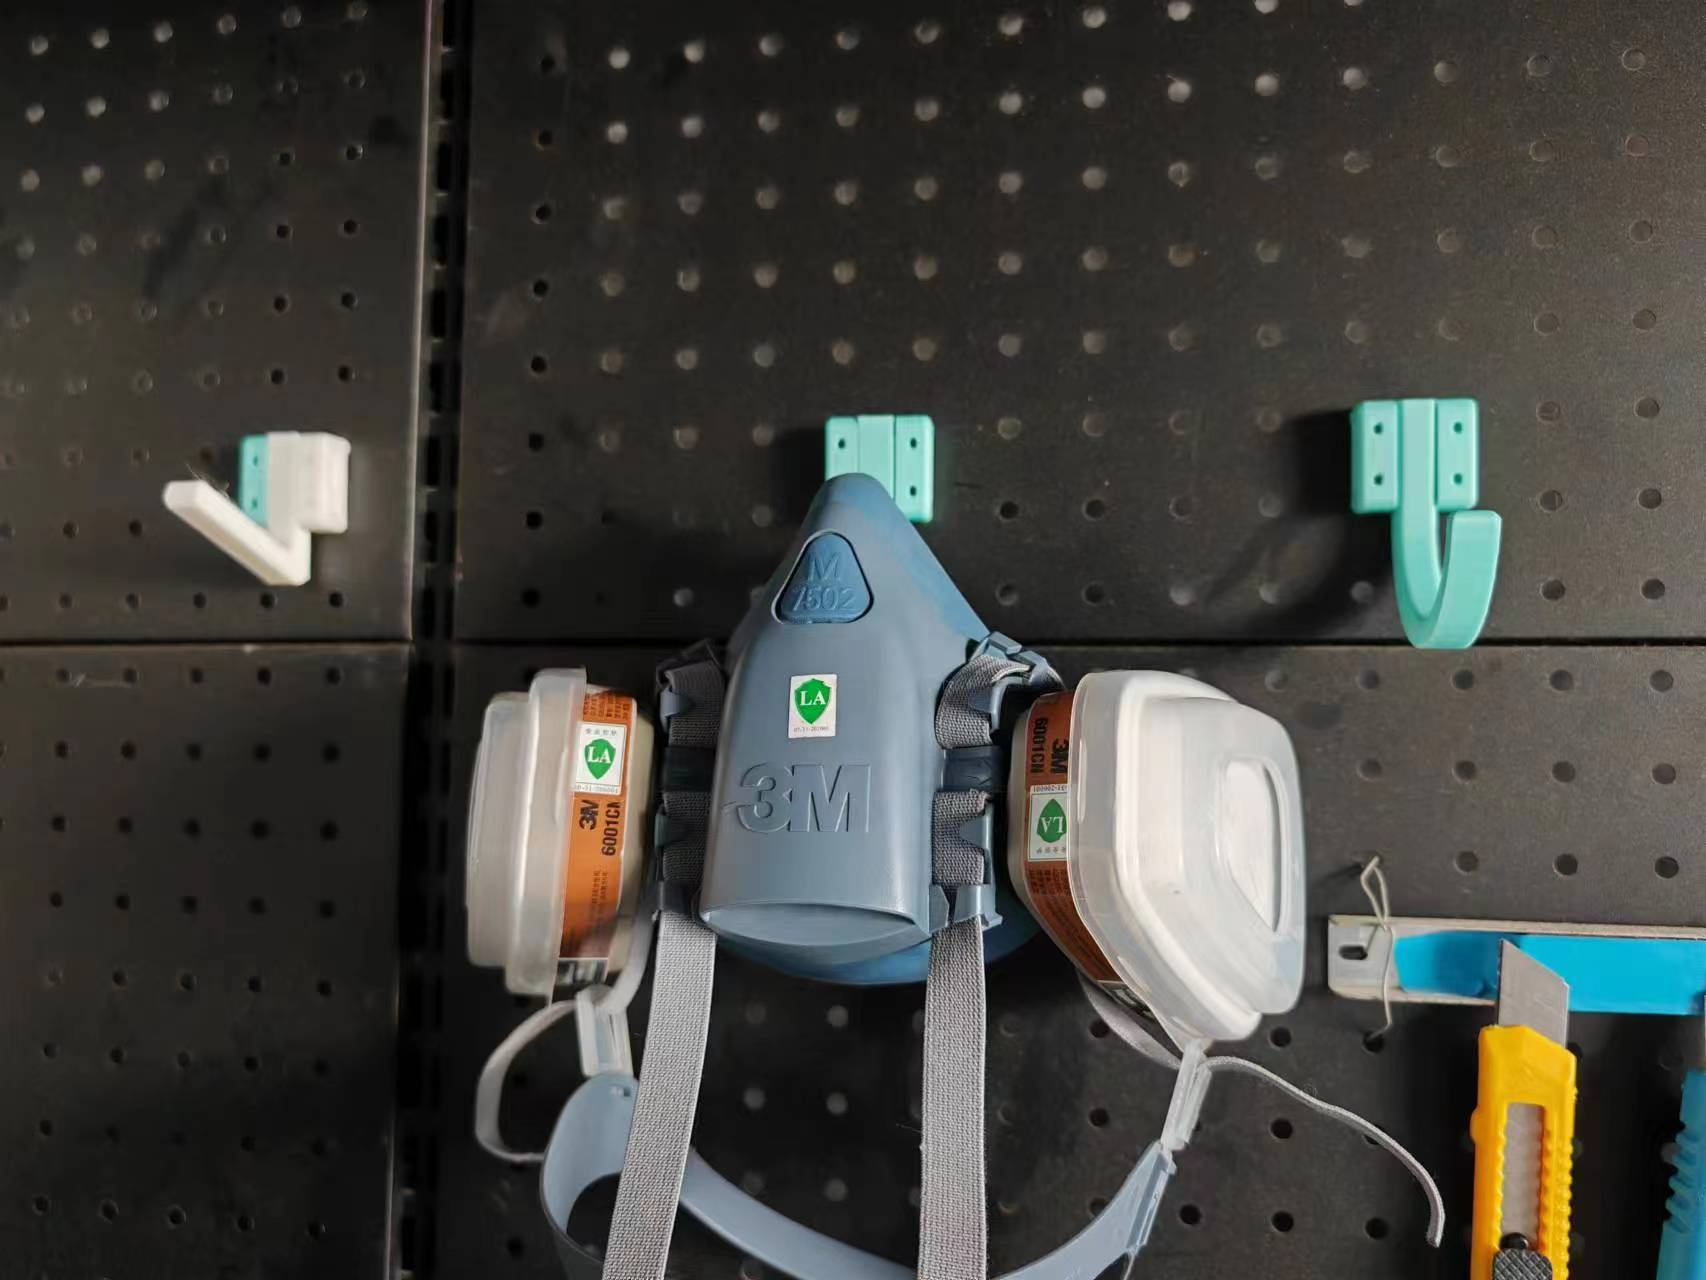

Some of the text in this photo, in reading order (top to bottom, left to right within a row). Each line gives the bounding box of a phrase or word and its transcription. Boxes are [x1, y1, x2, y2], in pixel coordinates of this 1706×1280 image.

[807, 552, 841, 582] M
[791, 586, 858, 612] 7502
[800, 689, 827, 706] LA
[587, 746, 612, 764] LA
[1030, 717, 1049, 774] 6001CN
[1050, 738, 1070, 775] 3M
[736, 761, 872, 834] 3M
[1040, 815, 1065, 834] LA
